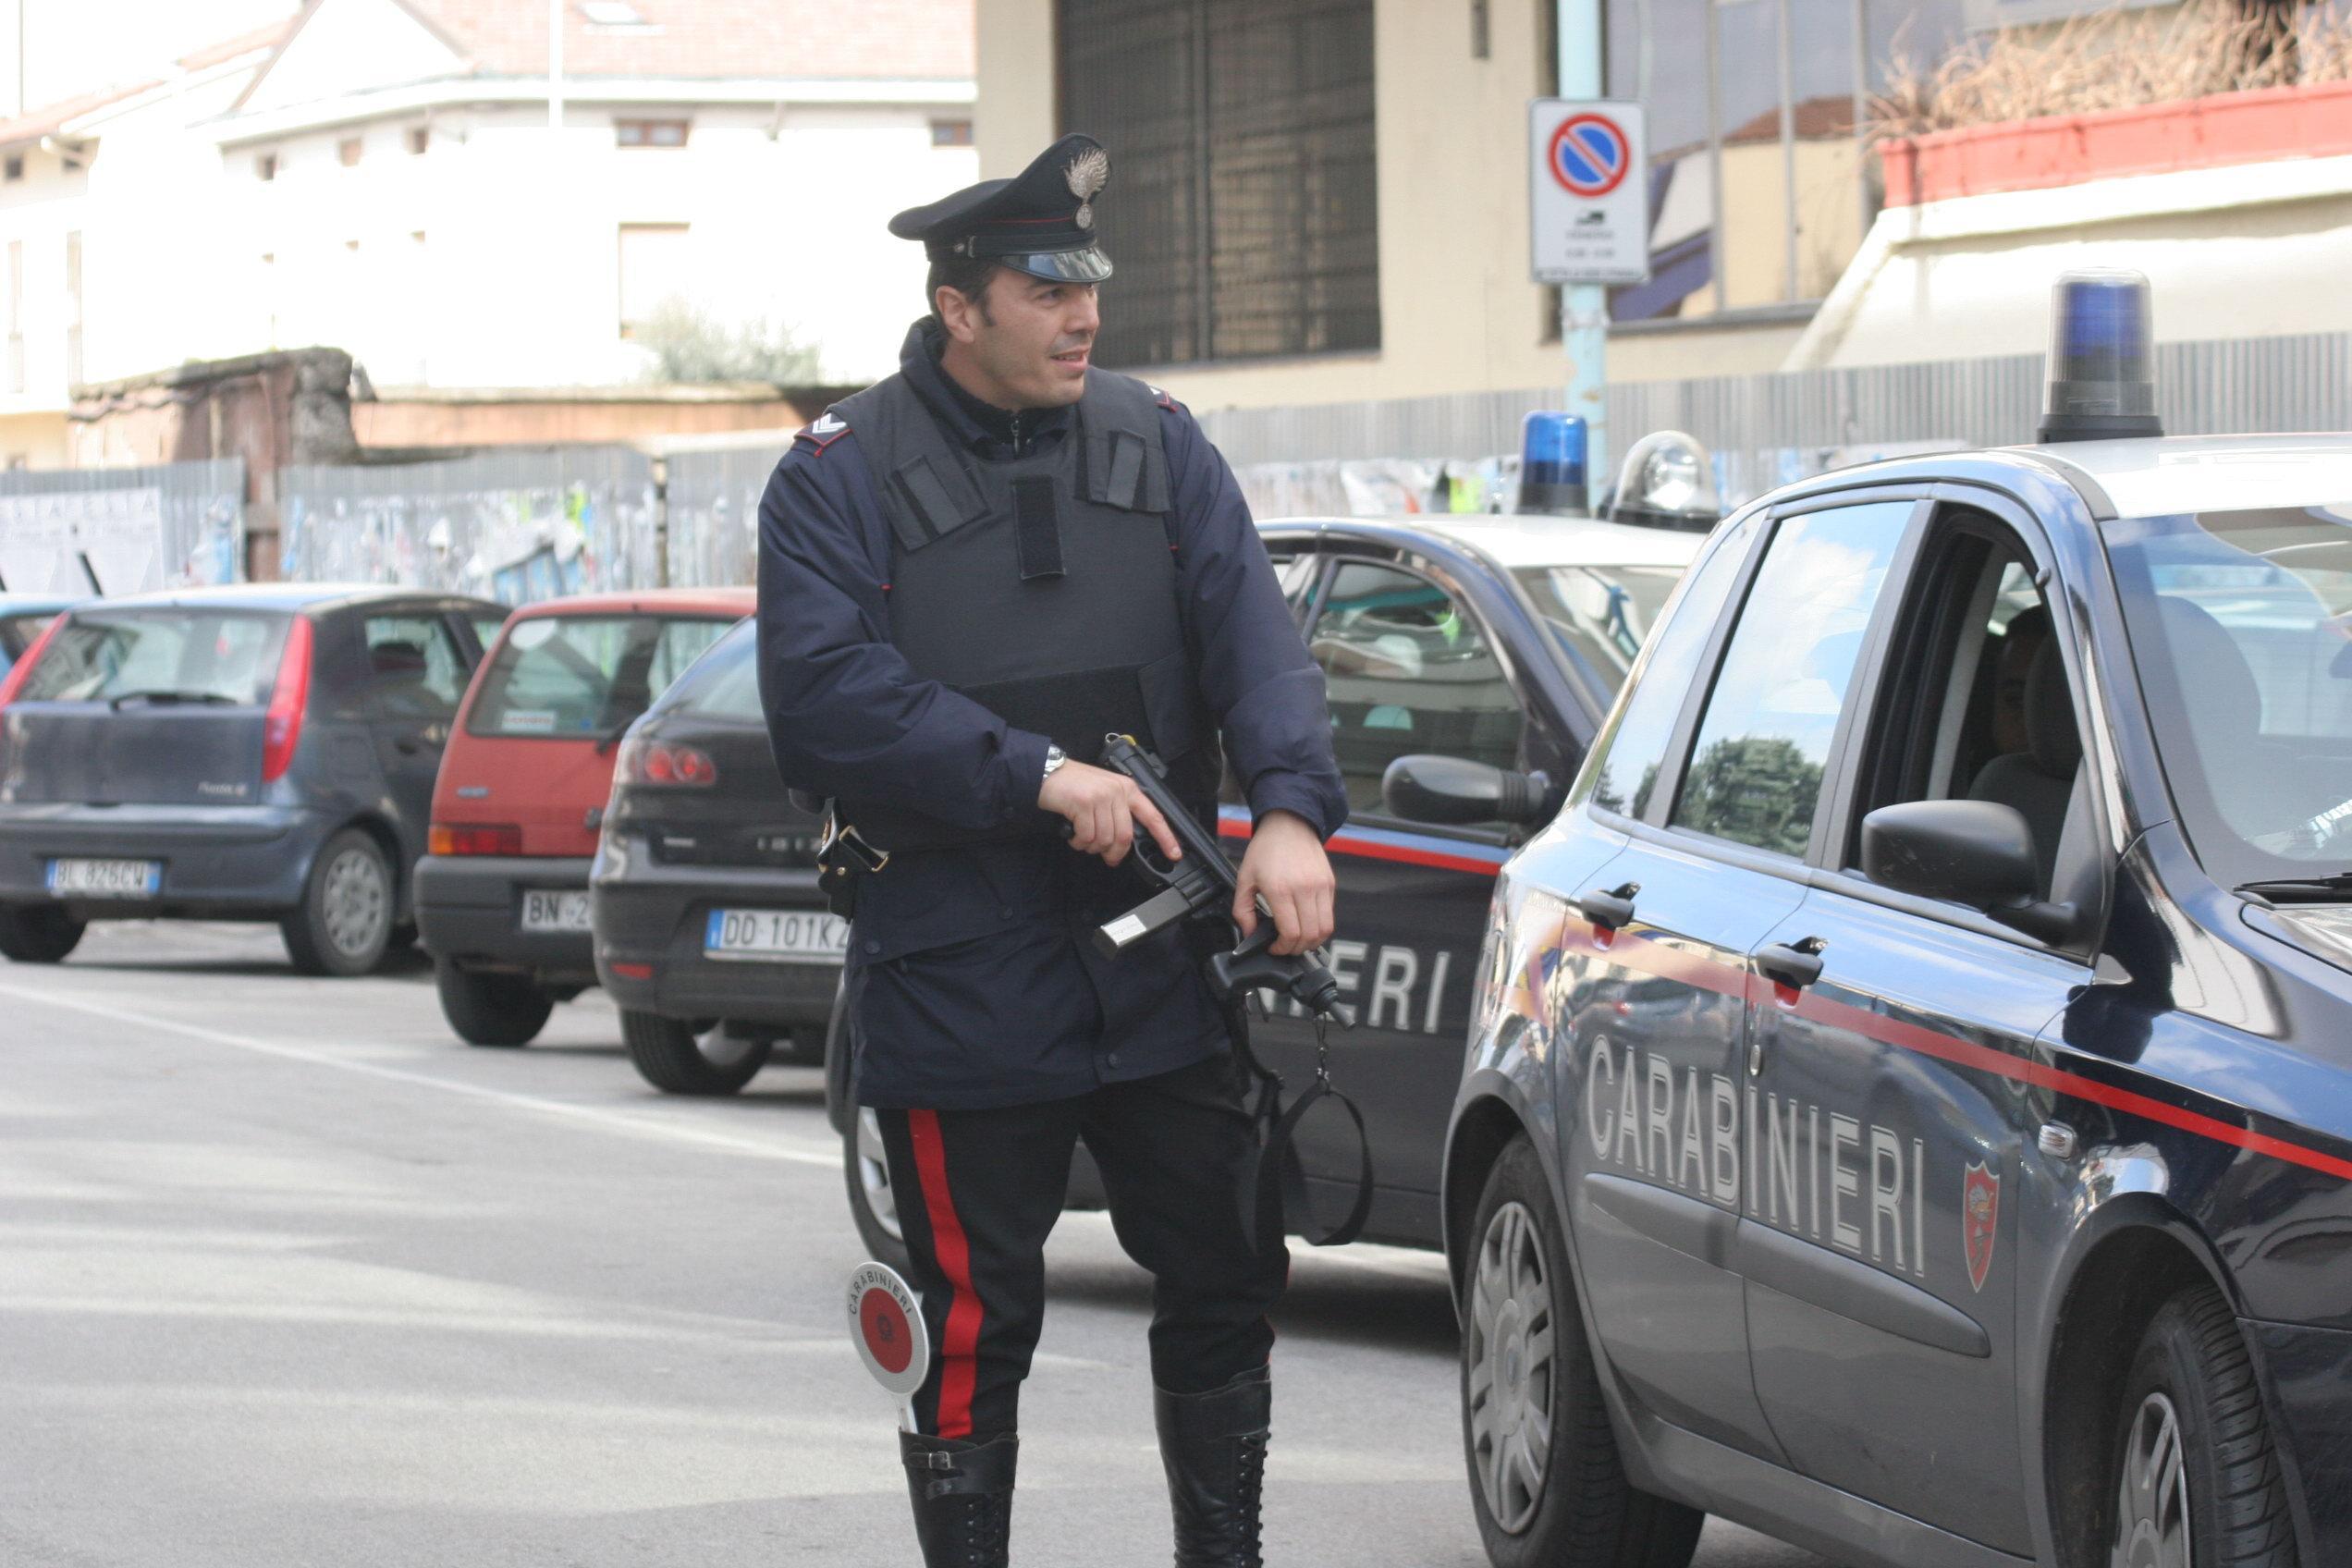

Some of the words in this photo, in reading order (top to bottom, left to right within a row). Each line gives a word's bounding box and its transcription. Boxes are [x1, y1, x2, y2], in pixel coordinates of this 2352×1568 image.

[529, 895, 560, 923] BN
[724, 914, 756, 945] DD
[1587, 1034, 1925, 1279] CARABINIERI
[848, 1270, 912, 1316] CARABINIERI
